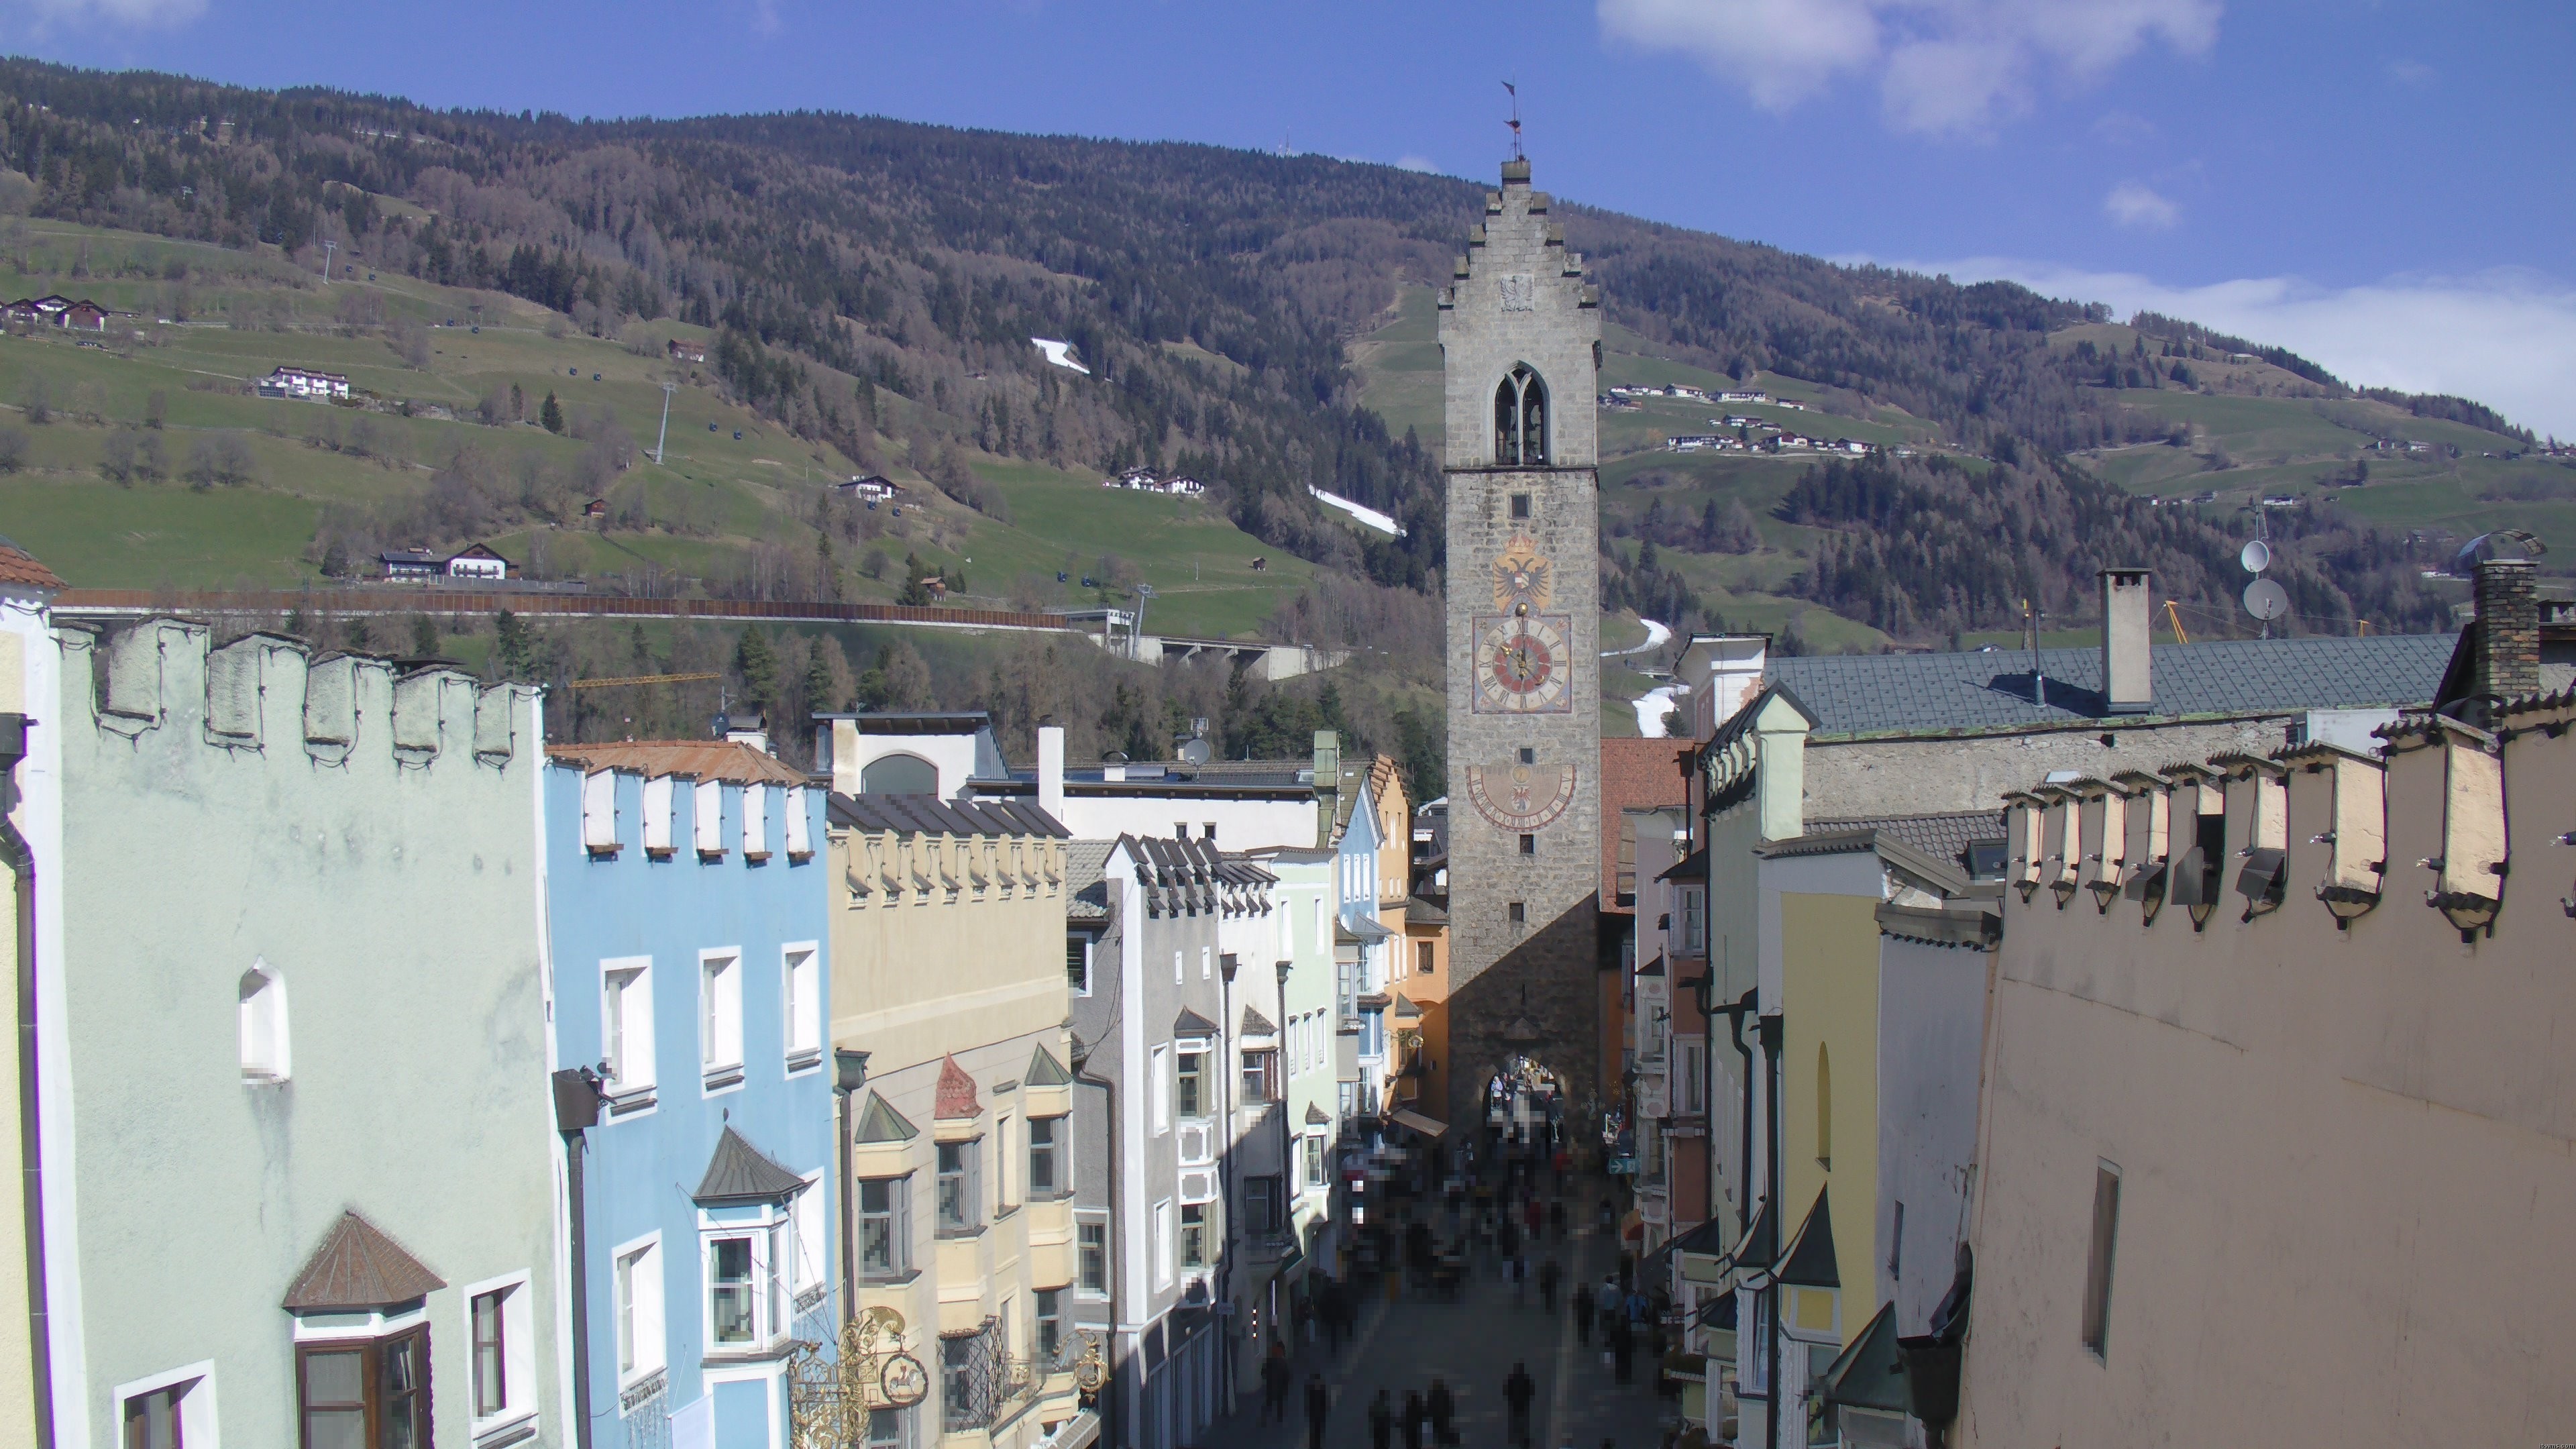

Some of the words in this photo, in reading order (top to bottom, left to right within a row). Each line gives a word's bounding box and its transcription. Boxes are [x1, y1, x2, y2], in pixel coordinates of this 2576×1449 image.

[1538, 625, 1544, 637] I
[1548, 639, 1562, 650] II
[1479, 659, 1491, 668] IX
[1482, 676, 1497, 692] VIII
[1549, 676, 1562, 689] IV
[1497, 690, 1510, 705] VII
[1538, 690, 1548, 704] V
